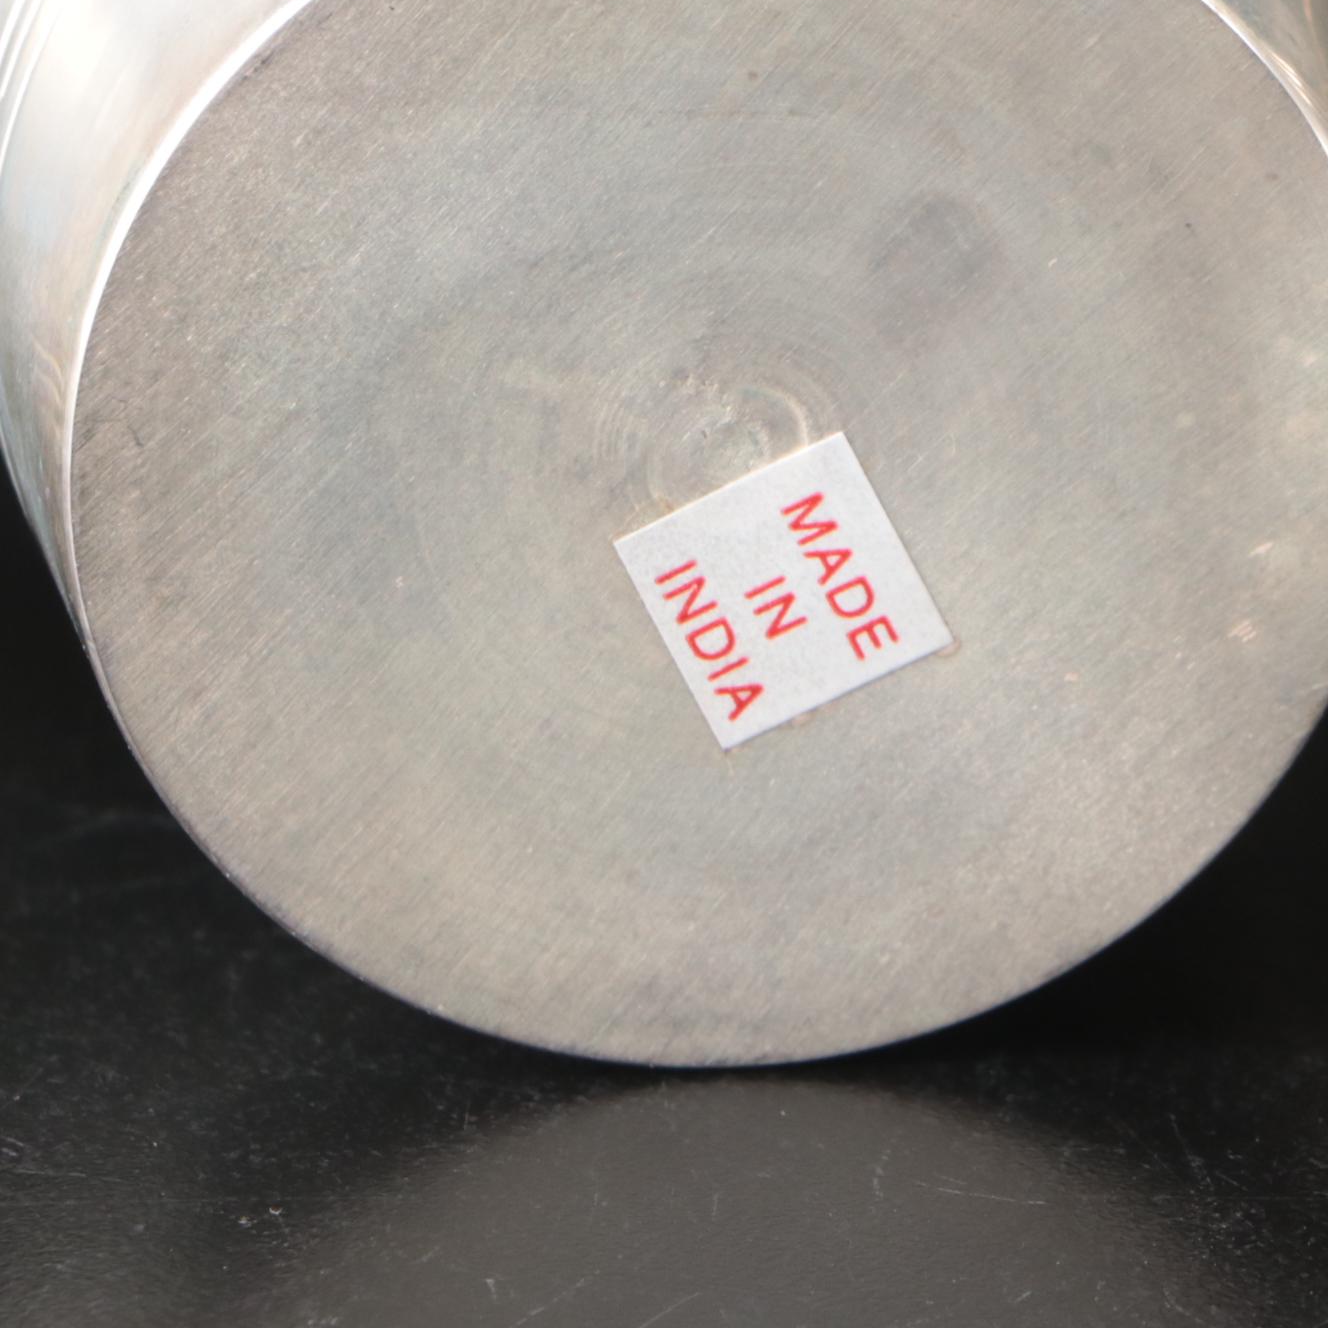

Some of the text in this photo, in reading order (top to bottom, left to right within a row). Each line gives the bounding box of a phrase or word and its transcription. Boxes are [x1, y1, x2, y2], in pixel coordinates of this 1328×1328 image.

[655, 559, 766, 722] INDIA
[744, 575, 809, 641] IN
[780, 491, 902, 662] MADE
